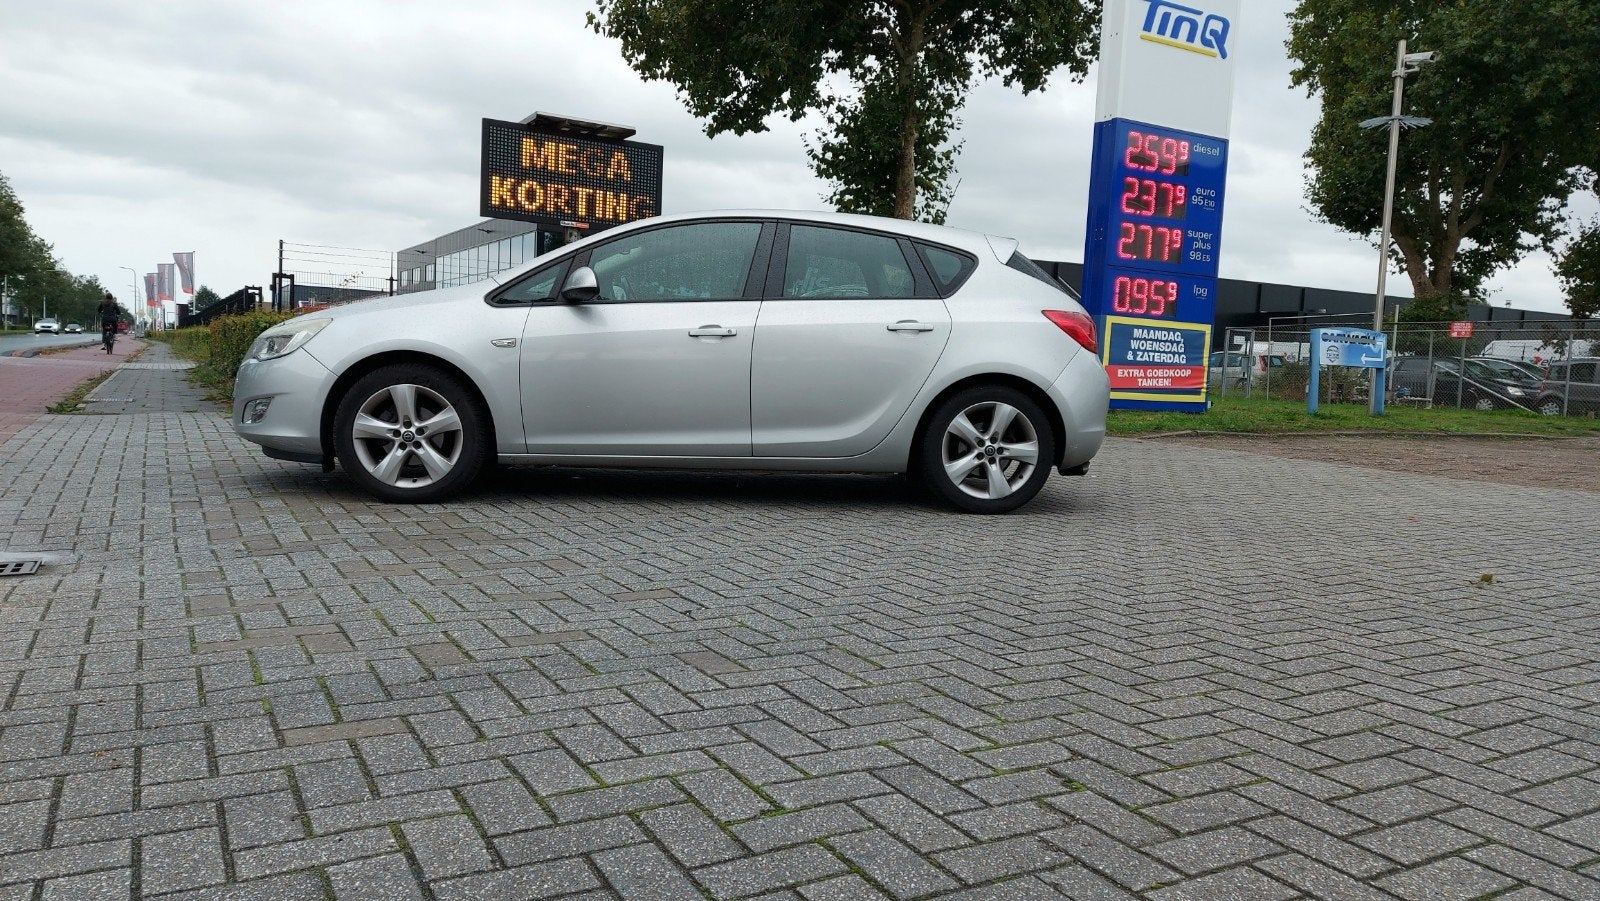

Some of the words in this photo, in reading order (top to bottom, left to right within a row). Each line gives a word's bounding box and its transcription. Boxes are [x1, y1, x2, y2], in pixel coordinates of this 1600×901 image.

[1193, 143, 1220, 156] diesel
[521, 137, 631, 181] MEGA
[491, 175, 654, 221] KORTING
[1196, 187, 1216, 197] euro
[1191, 196, 1204, 206] 95
[1204, 200, 1215, 208] E10
[1187, 229, 1212, 240] super
[1193, 239, 1211, 250] plus
[1189, 251, 1202, 261] 98
[1202, 254, 1211, 262] E5
[1193, 284, 1208, 296] lpg
[1133, 328, 1184, 343] MAANDAG,
[1130, 340, 1185, 352] WOENSDAG
[1126, 350, 1134, 361] &
[1136, 351, 1187, 364] ZATERDAG
[1117, 369, 1145, 377] EXTRA
[1147, 369, 1191, 377] GOEDKOOP
[1137, 378, 1172, 387] TANKEN!
